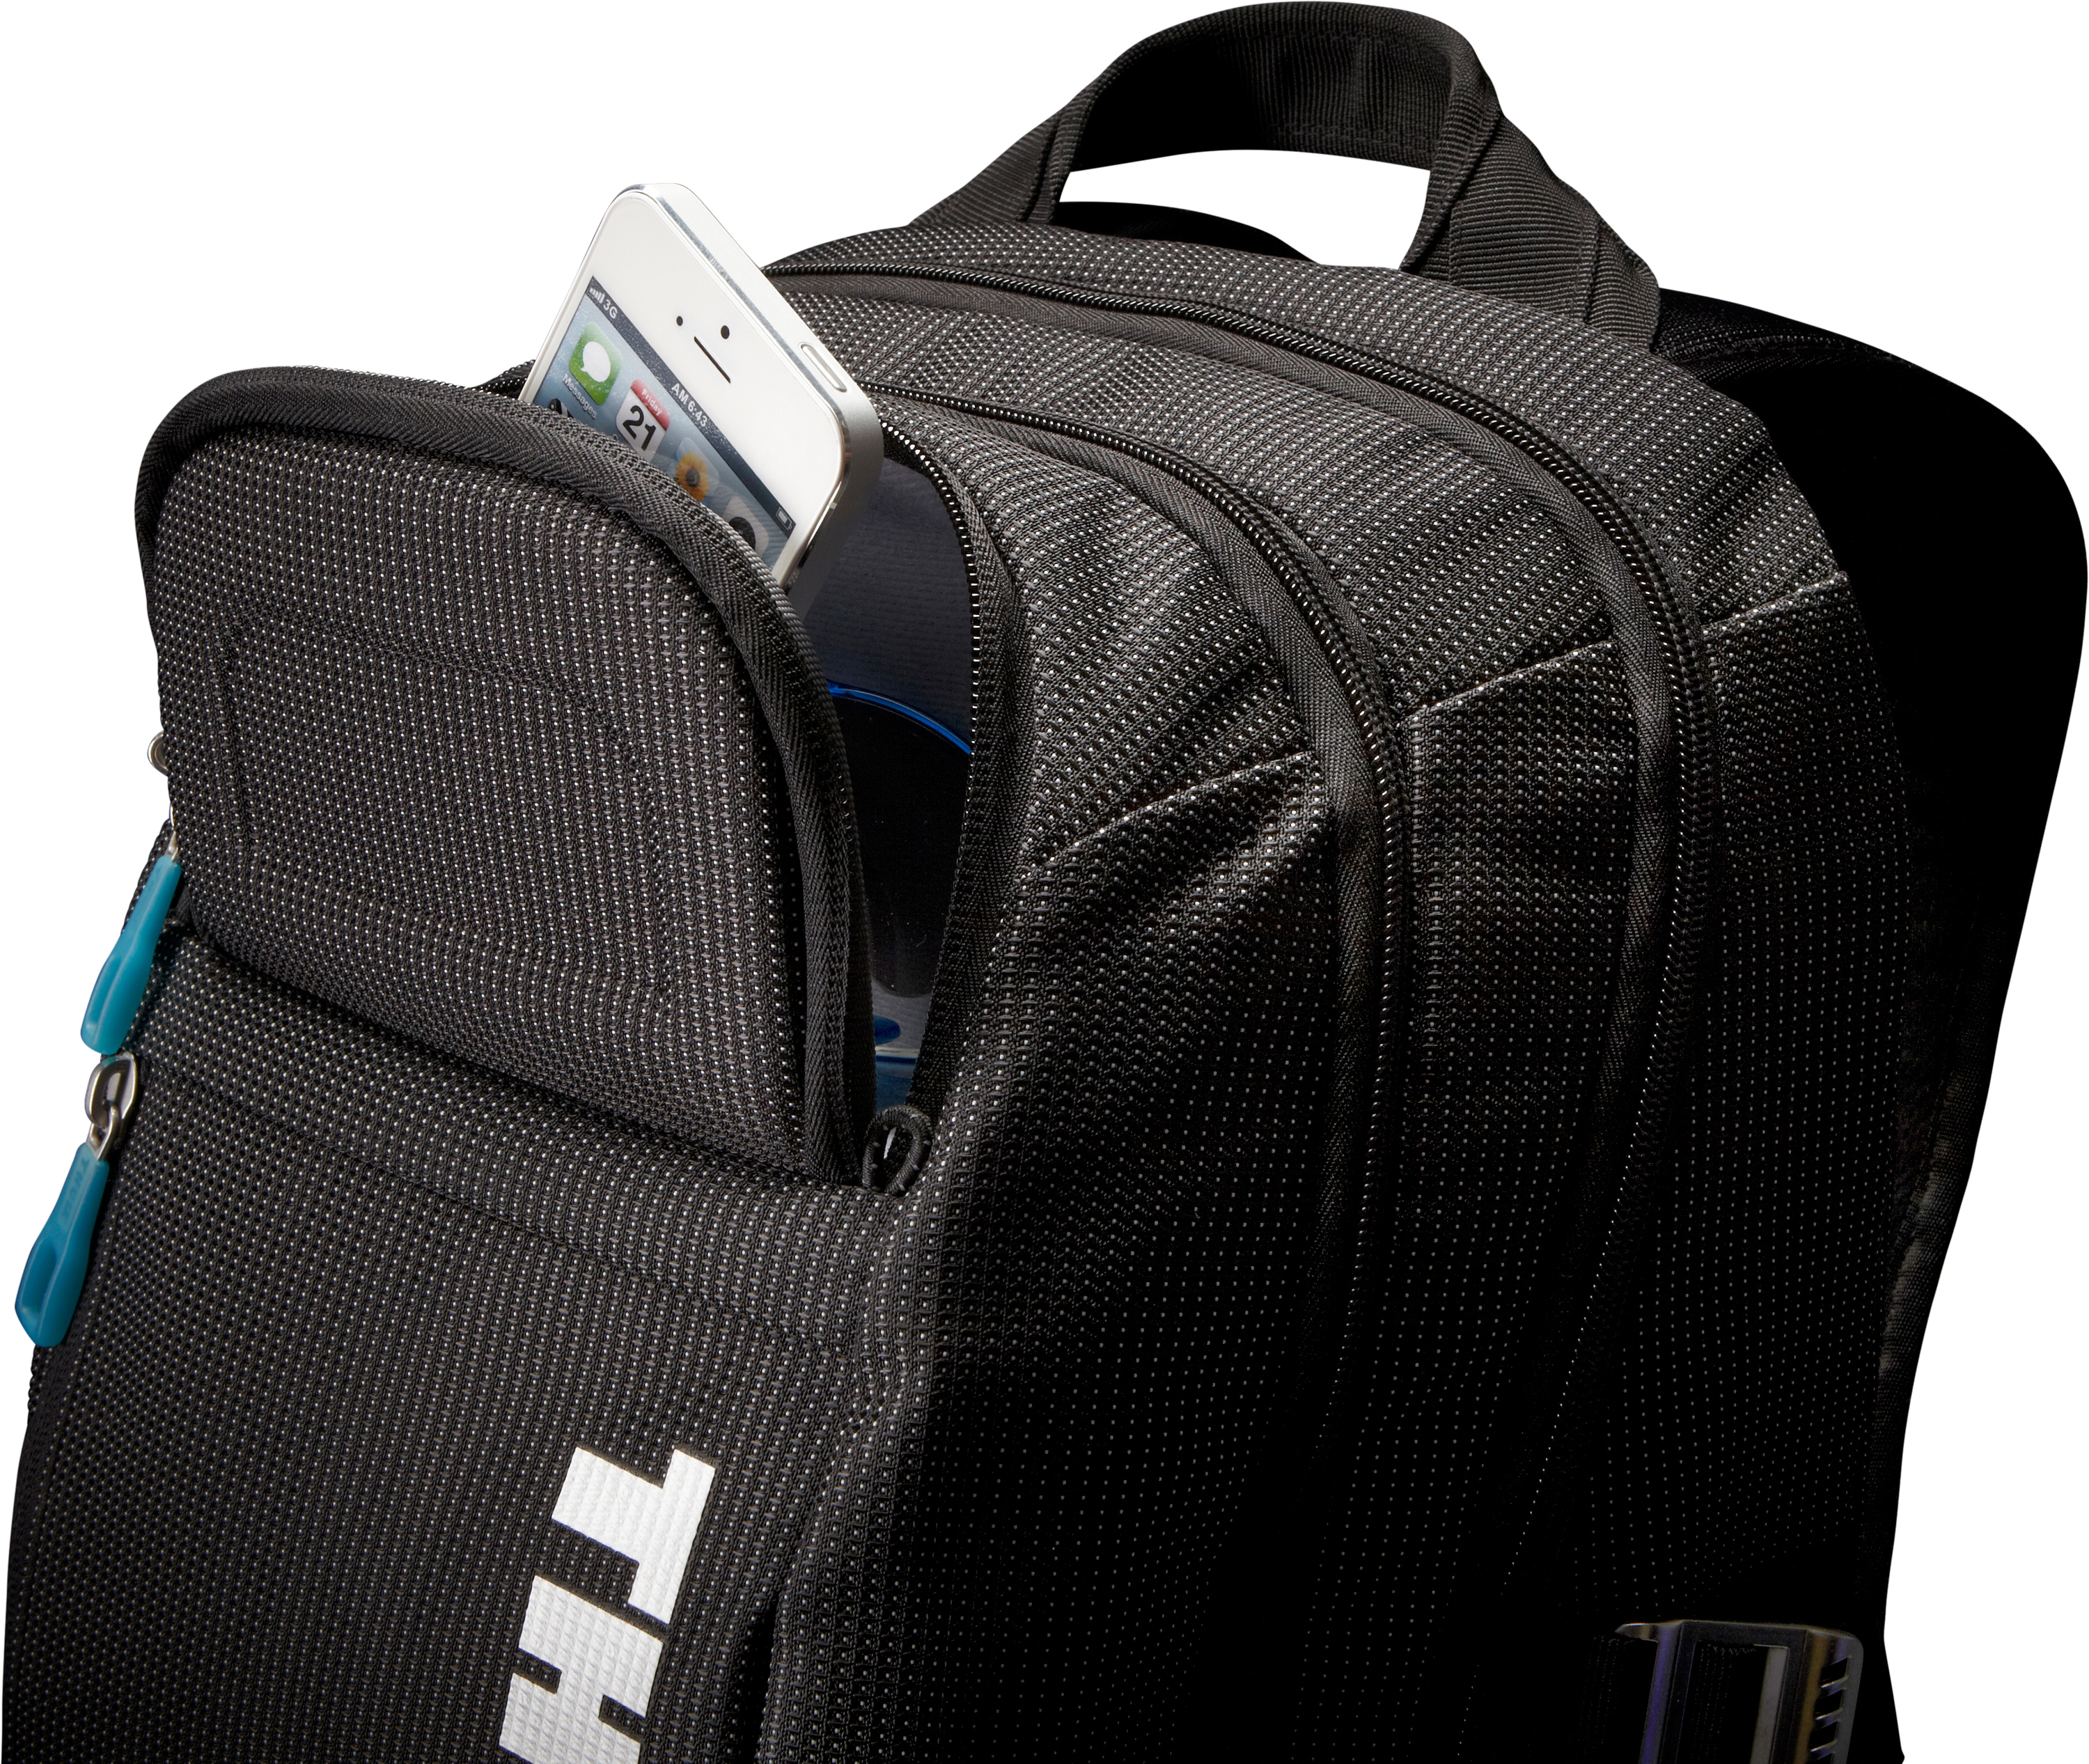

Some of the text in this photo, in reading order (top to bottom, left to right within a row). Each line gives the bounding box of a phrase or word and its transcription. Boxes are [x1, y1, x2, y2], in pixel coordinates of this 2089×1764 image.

[603, 299, 618, 320] 3G
[562, 373, 598, 419] Messages
[641, 388, 662, 416] Friday
[671, 382, 708, 427] AM 6:43
[622, 405, 657, 451] 21
